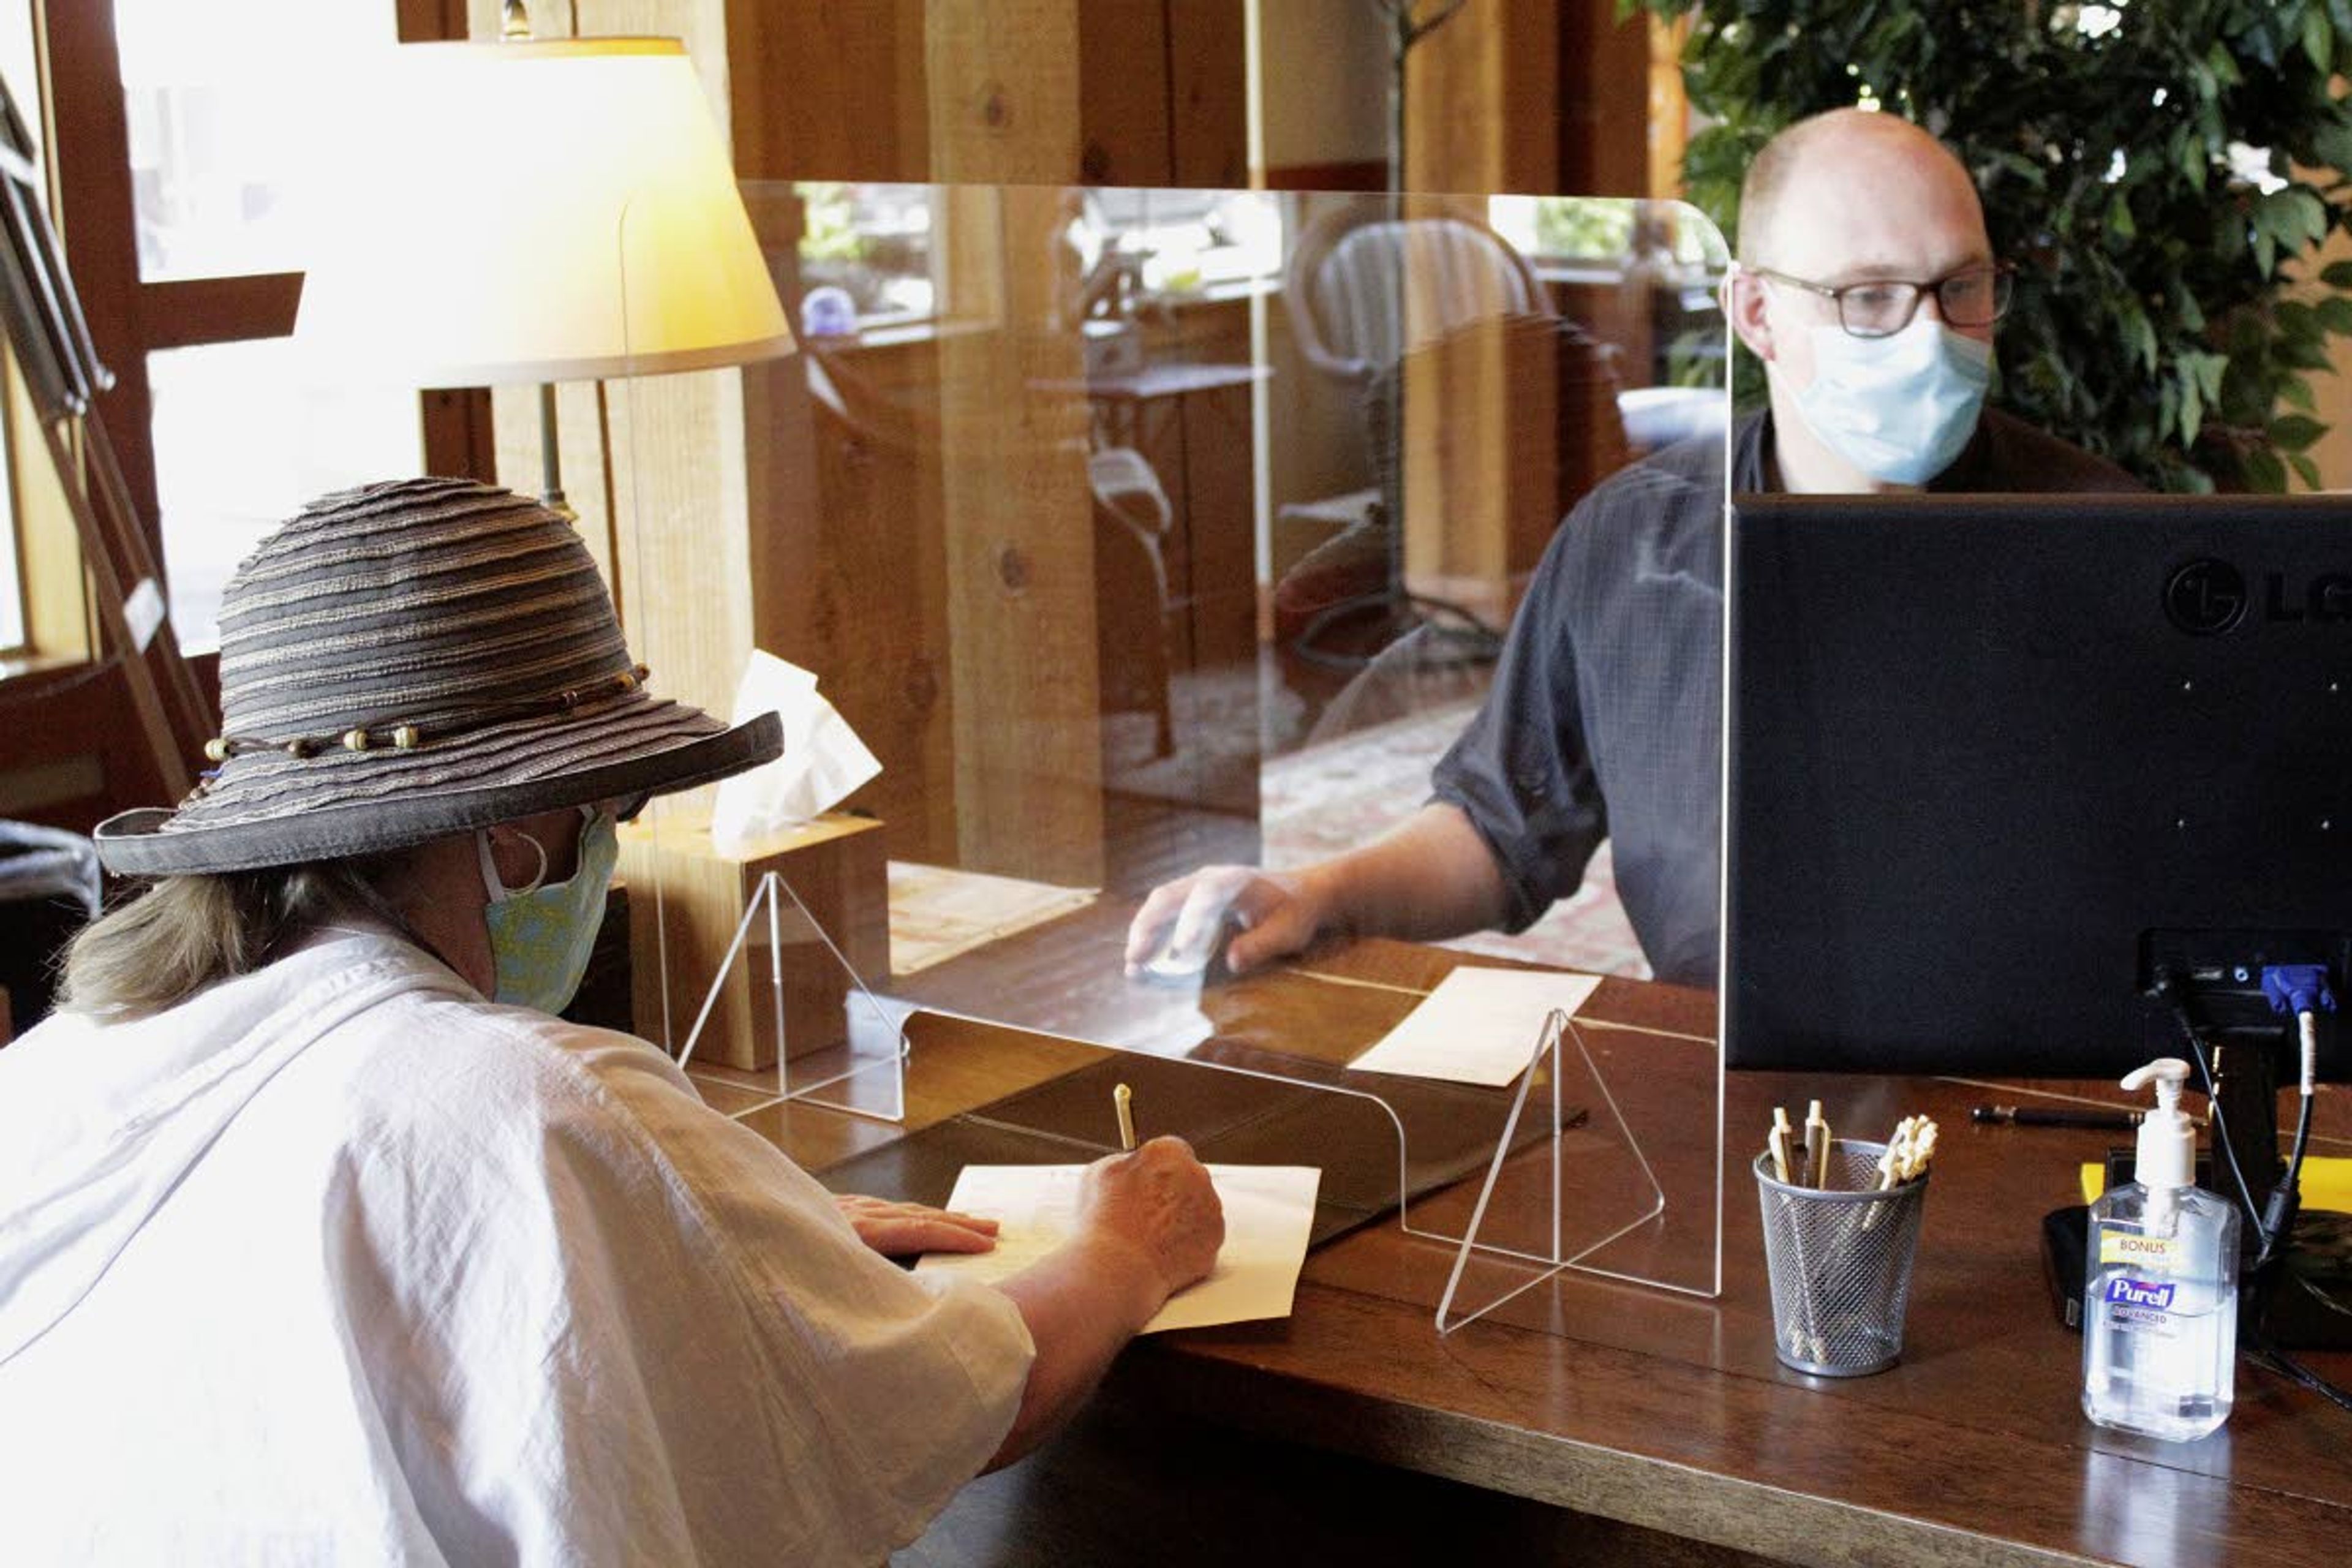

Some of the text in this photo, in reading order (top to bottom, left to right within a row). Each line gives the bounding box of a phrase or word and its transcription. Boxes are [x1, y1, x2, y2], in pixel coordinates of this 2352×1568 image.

[2267, 571, 2352, 622] LG
[2120, 1238, 2166, 1254] BONUS
[2112, 1279, 2169, 1306] Purell
